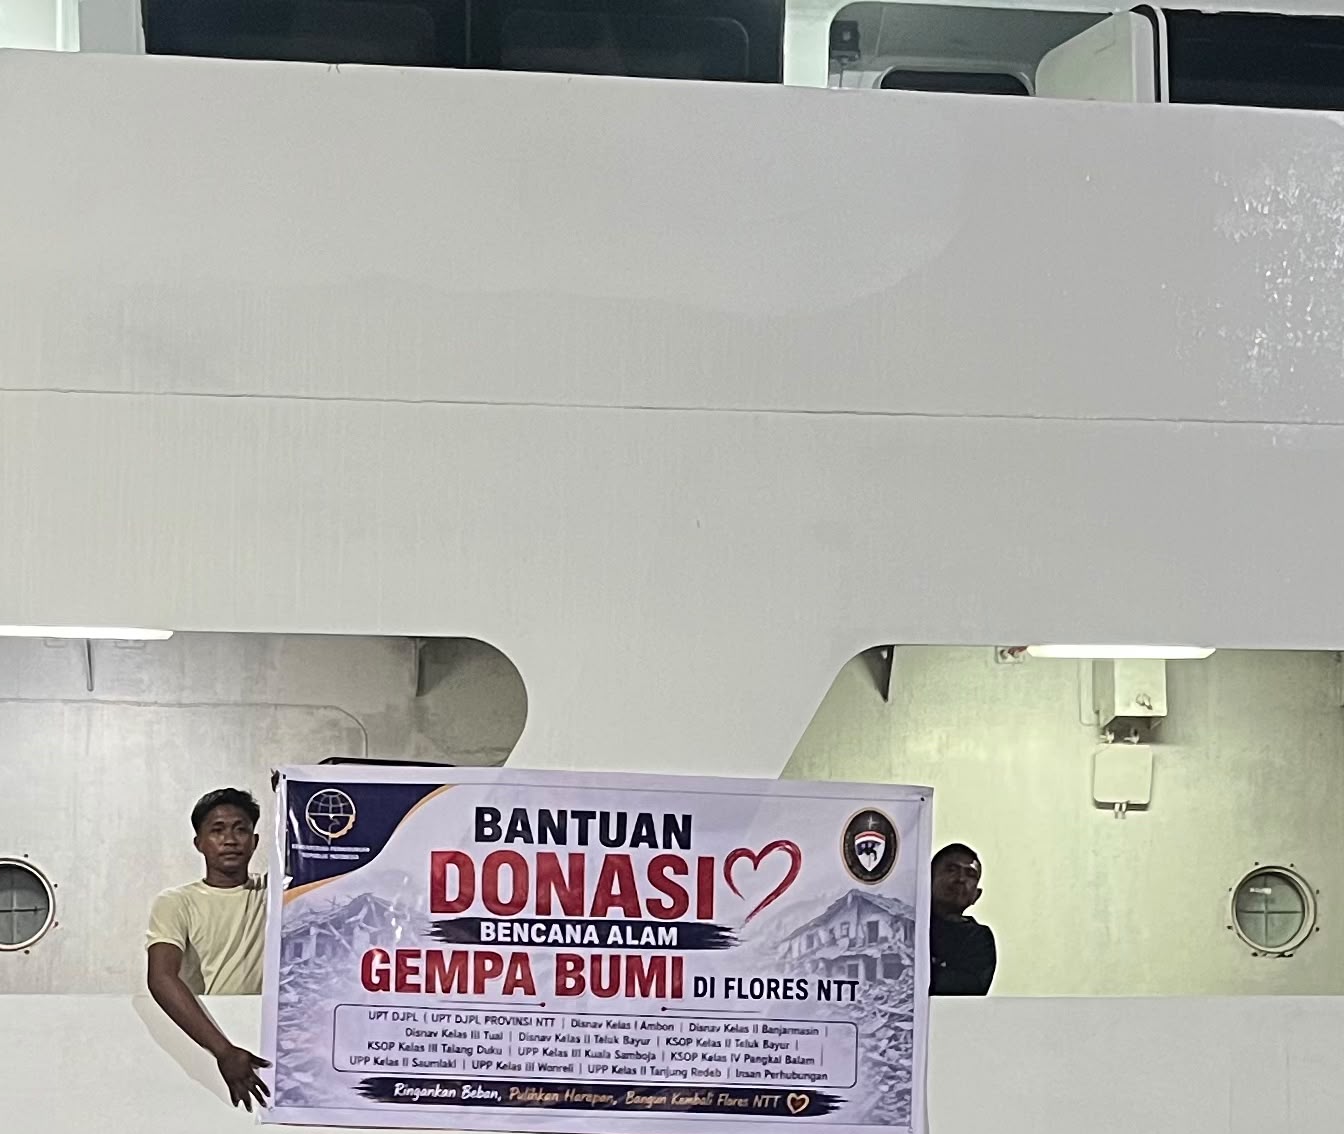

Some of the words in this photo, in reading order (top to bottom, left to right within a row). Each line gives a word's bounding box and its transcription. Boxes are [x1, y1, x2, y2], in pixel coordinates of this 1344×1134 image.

[475, 806, 692, 851] BANTUAN
[429, 850, 714, 919] DONASI
[480, 921, 599, 945] BENCANA
[606, 924, 678, 946] ALAM
[361, 948, 535, 997] GEMPA
[555, 954, 684, 999] BUMI
[693, 976, 716, 998] DI
[723, 977, 809, 1001] FLORES
[817, 979, 860, 1002] NTT
[368, 1011, 388, 1021] UPT
[392, 1011, 418, 1022] DJPL
[431, 1013, 451, 1024] UPT
[455, 1014, 481, 1025] DJPL
[484, 1015, 533, 1027] PROVINSI
[536, 1016, 556, 1028] NTT
[571, 1018, 603, 1030] Disnav
[606, 1019, 631, 1030] Kelas
[640, 1020, 675, 1031] Ambon
[689, 1023, 721, 1033] Disnav
[724, 1023, 749, 1034] Kelas
[762, 1025, 819, 1037] Banjarmasin
[406, 1027, 438, 1039] Disnav
[441, 1028, 467, 1040] Kelas
[484, 1030, 504, 1041] Tual
[519, 1033, 552, 1043] Disnav
[555, 1034, 581, 1044] Kelas
[594, 1035, 619, 1045] Teluk
[623, 1036, 651, 1048] Bayur
[665, 1037, 693, 1047] KSOP
[696, 1038, 721, 1048] Kelas
[763, 1039, 790, 1052] Bayur
[367, 1041, 395, 1051] KSOP
[398, 1042, 425, 1053] Kelas
[518, 1046, 539, 1056] UPP
[542, 1047, 568, 1058] Kelas
[584, 1049, 611, 1059] Kuala
[614, 1050, 656, 1063] Samboja
[670, 1051, 698, 1061] KSOP
[701, 1052, 727, 1063] Kelas
[744, 1053, 781, 1066] Pangkal
[785, 1054, 815, 1065] Balam
[349, 1055, 370, 1066] UPP
[373, 1056, 399, 1067] Kelas
[472, 1059, 493, 1070] UPP
[495, 1061, 522, 1072] Kelas
[587, 1064, 609, 1074] UPP
[611, 1065, 637, 1075] Kelas
[650, 1066, 688, 1079] Tanjung
[764, 1069, 828, 1082] Perhubungan
[393, 1082, 457, 1102] Ringankan
[461, 1085, 503, 1102] Beban,
[752, 1095, 783, 1108] NTT
